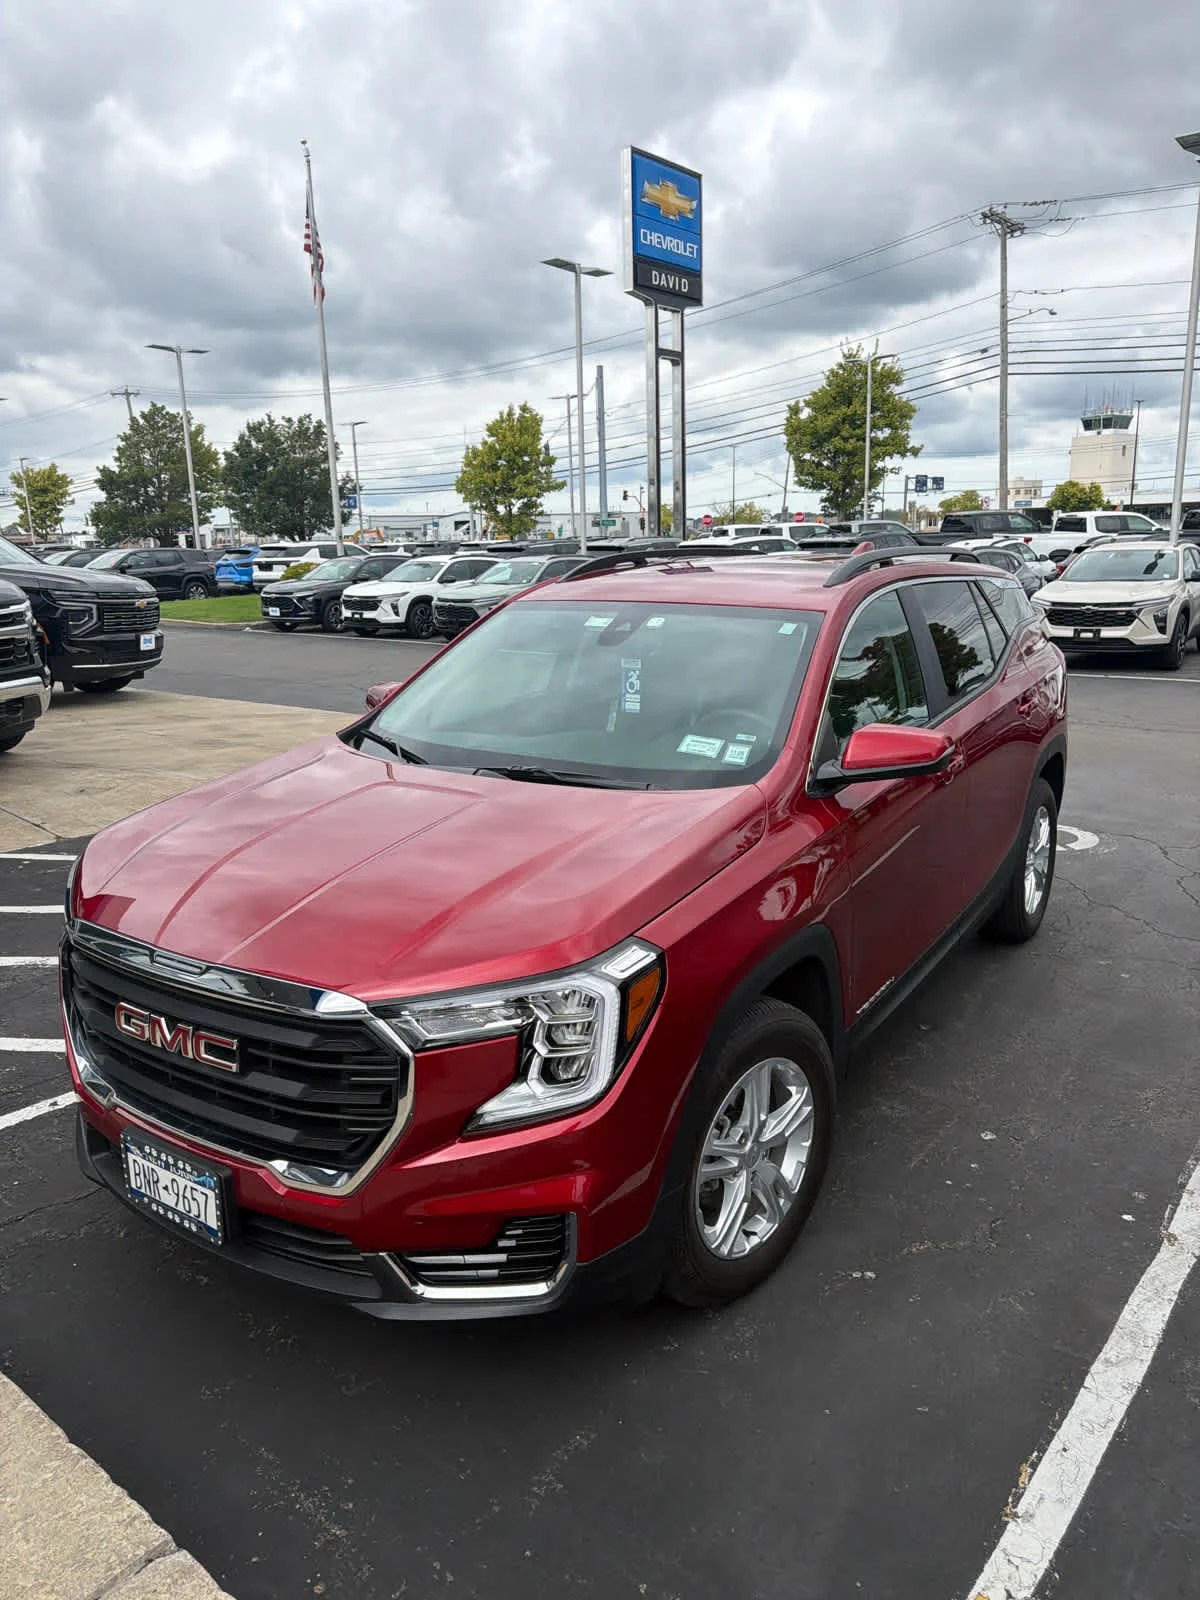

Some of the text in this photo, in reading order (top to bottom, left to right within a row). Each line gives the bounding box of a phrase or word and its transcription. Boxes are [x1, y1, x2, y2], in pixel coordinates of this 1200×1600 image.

[640, 228, 698, 258] CHEVROLET
[651, 270, 689, 293] DAVID
[115, 1001, 240, 1073] GMC
[170, 1177, 209, 1224] 9657
